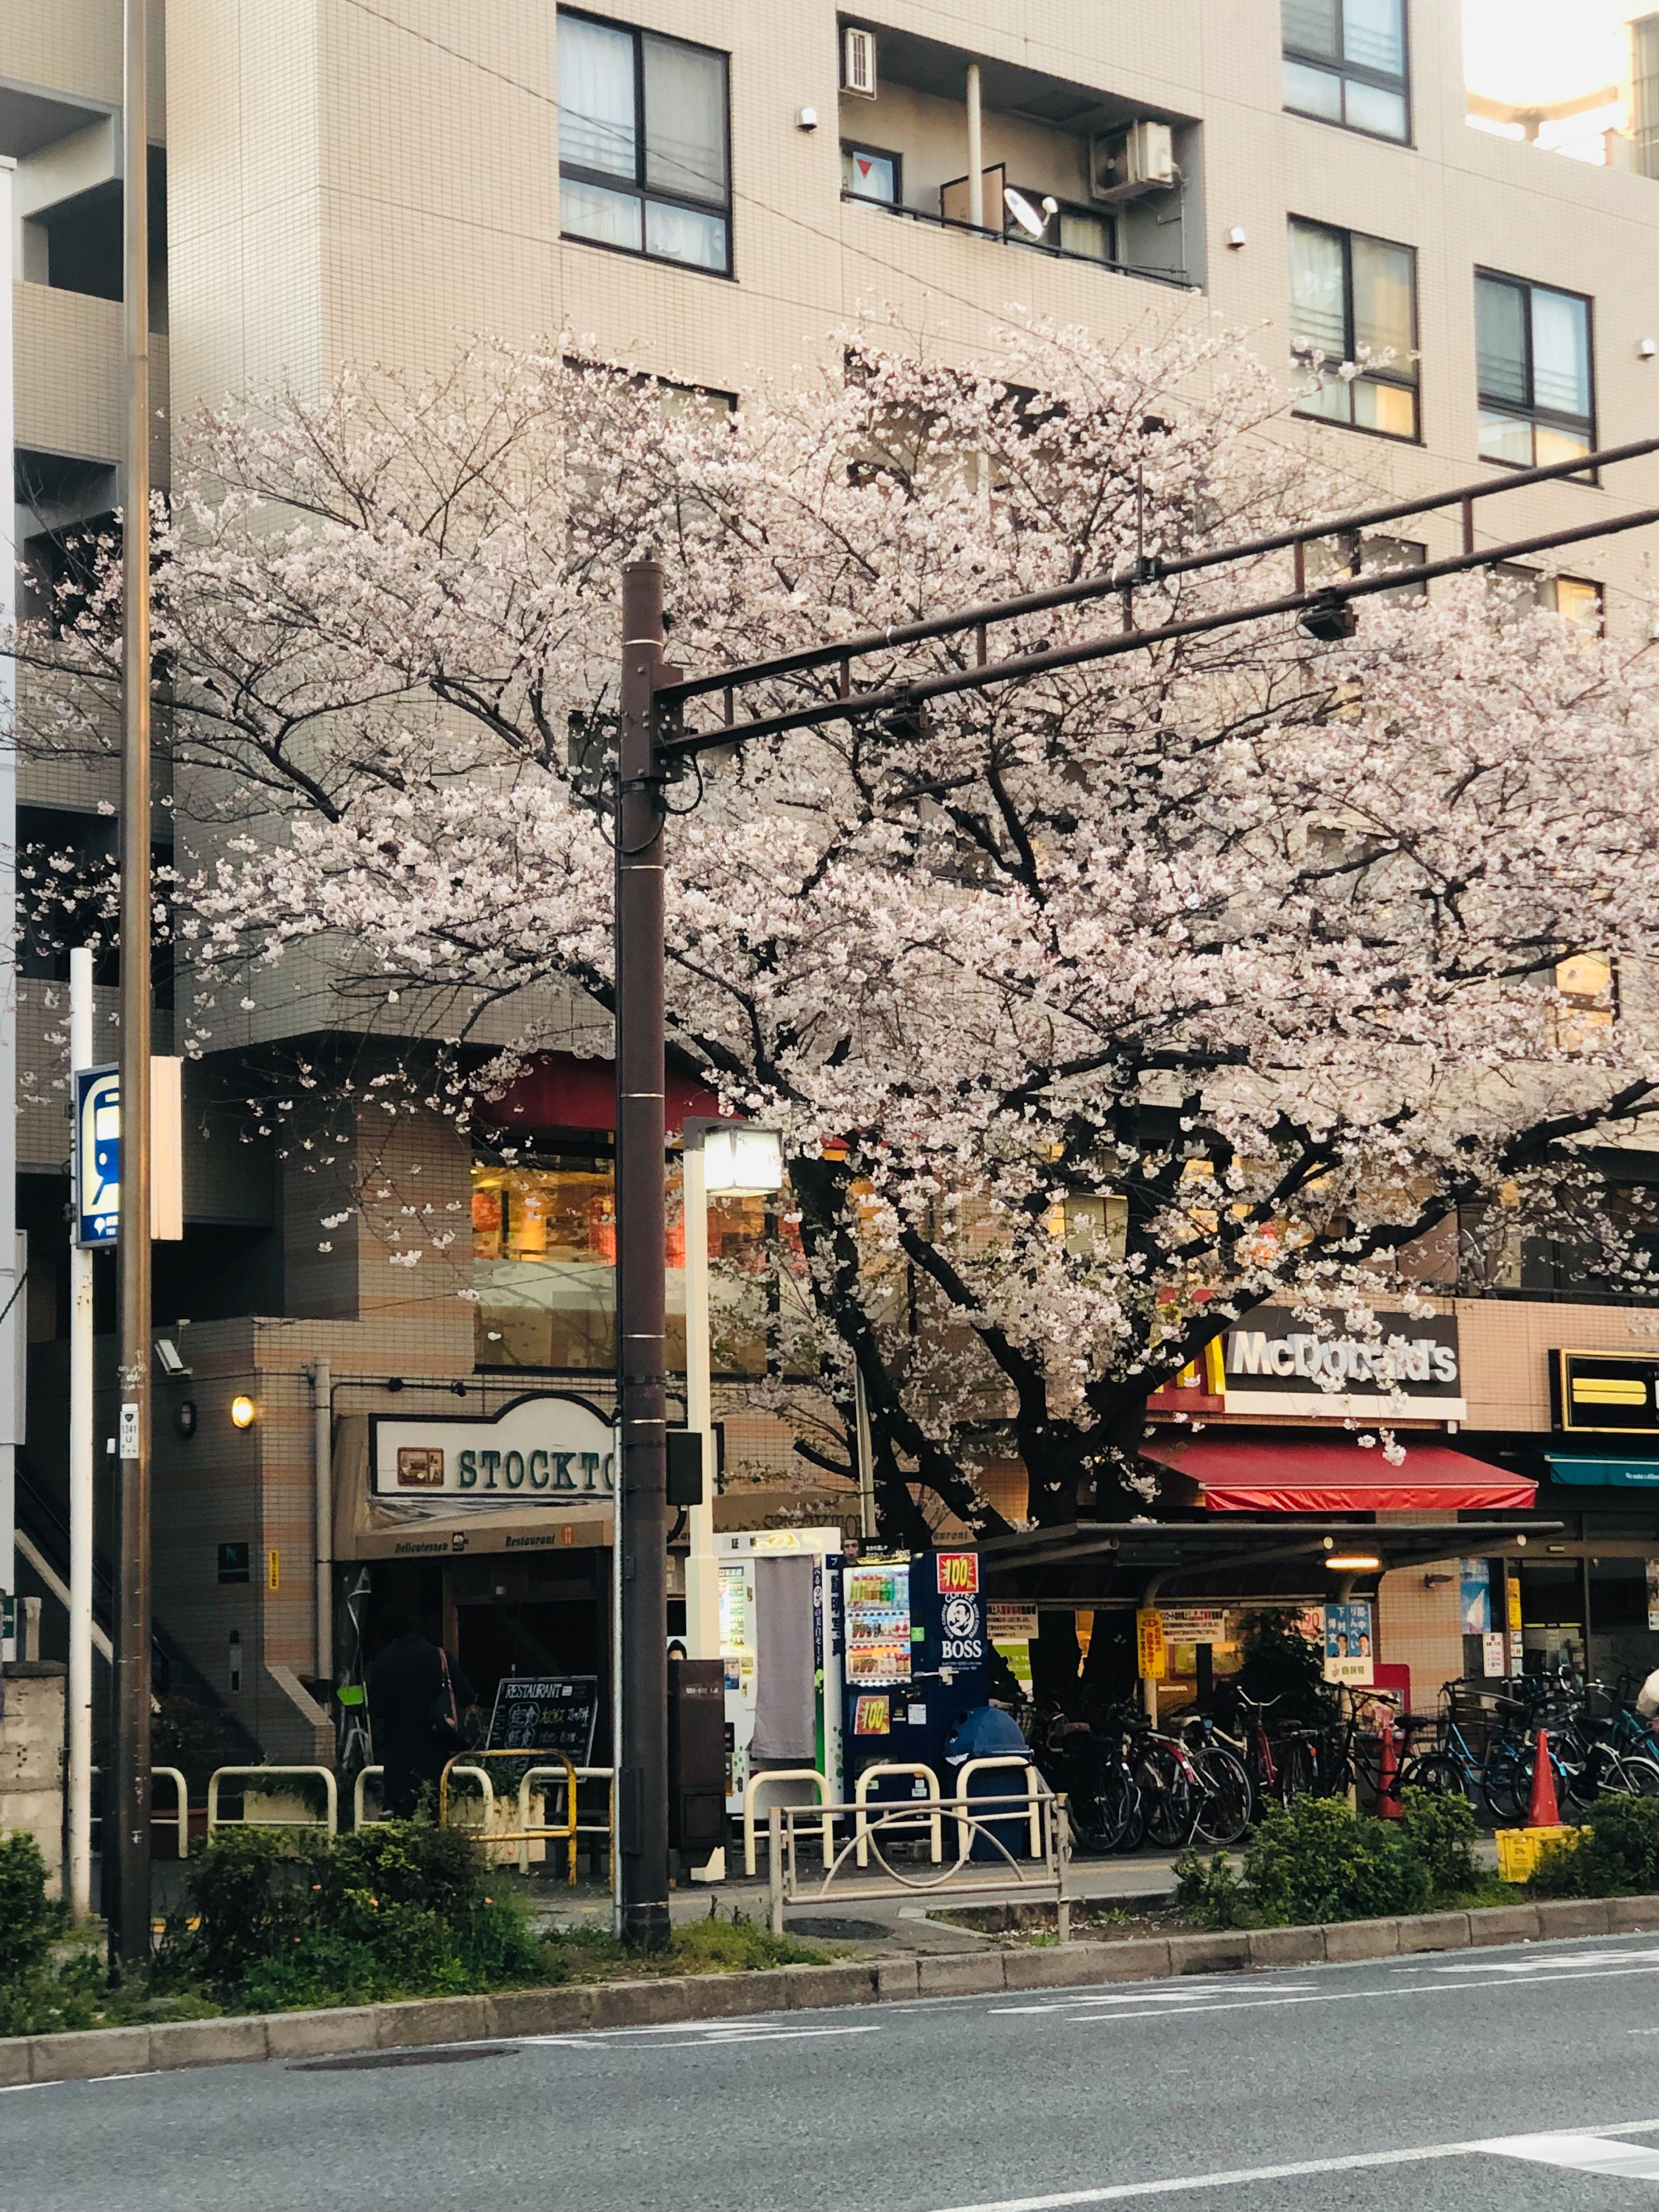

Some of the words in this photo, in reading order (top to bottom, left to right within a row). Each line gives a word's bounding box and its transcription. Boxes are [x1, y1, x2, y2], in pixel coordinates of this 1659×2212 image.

[394, 1542, 448, 1554] Delicatessen
[505, 1534, 556, 1547] Restaurant
[945, 1559, 968, 1587] 100
[1336, 1607, 1346, 1632] 下村
[941, 1639, 982, 1658] BOSS
[505, 1683, 562, 1699] RESTAURANT
[863, 1701, 885, 1729] 100
